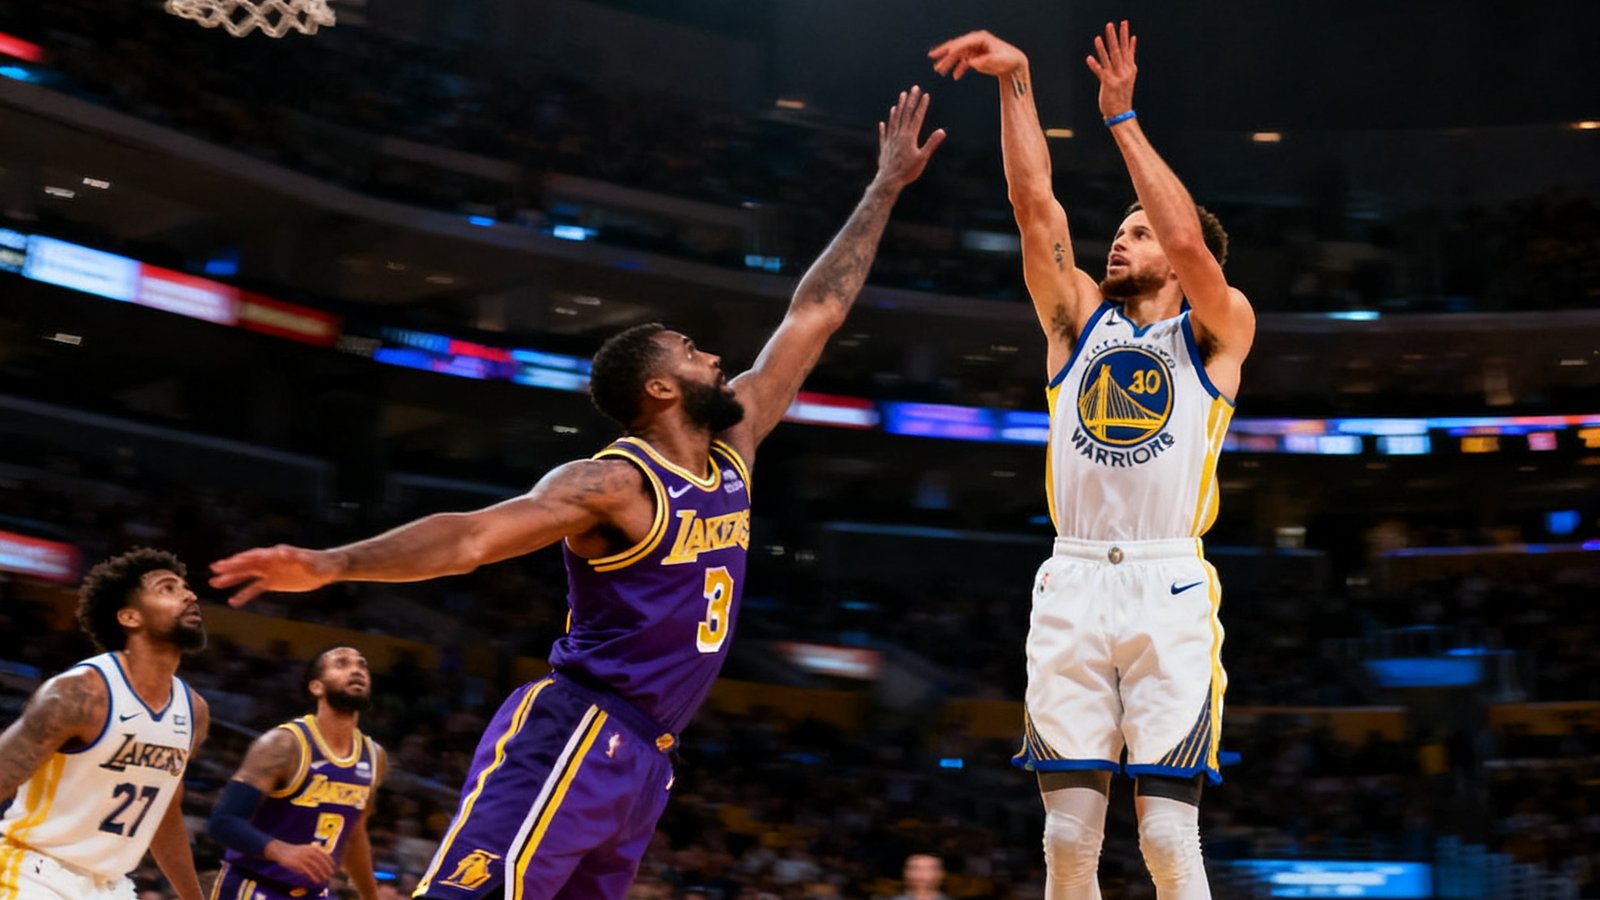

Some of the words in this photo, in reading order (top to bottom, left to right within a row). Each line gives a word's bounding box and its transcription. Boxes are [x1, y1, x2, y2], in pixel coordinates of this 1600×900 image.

[696, 566, 734, 653] 3
[98, 782, 160, 838] 27
[310, 812, 345, 855] 9
